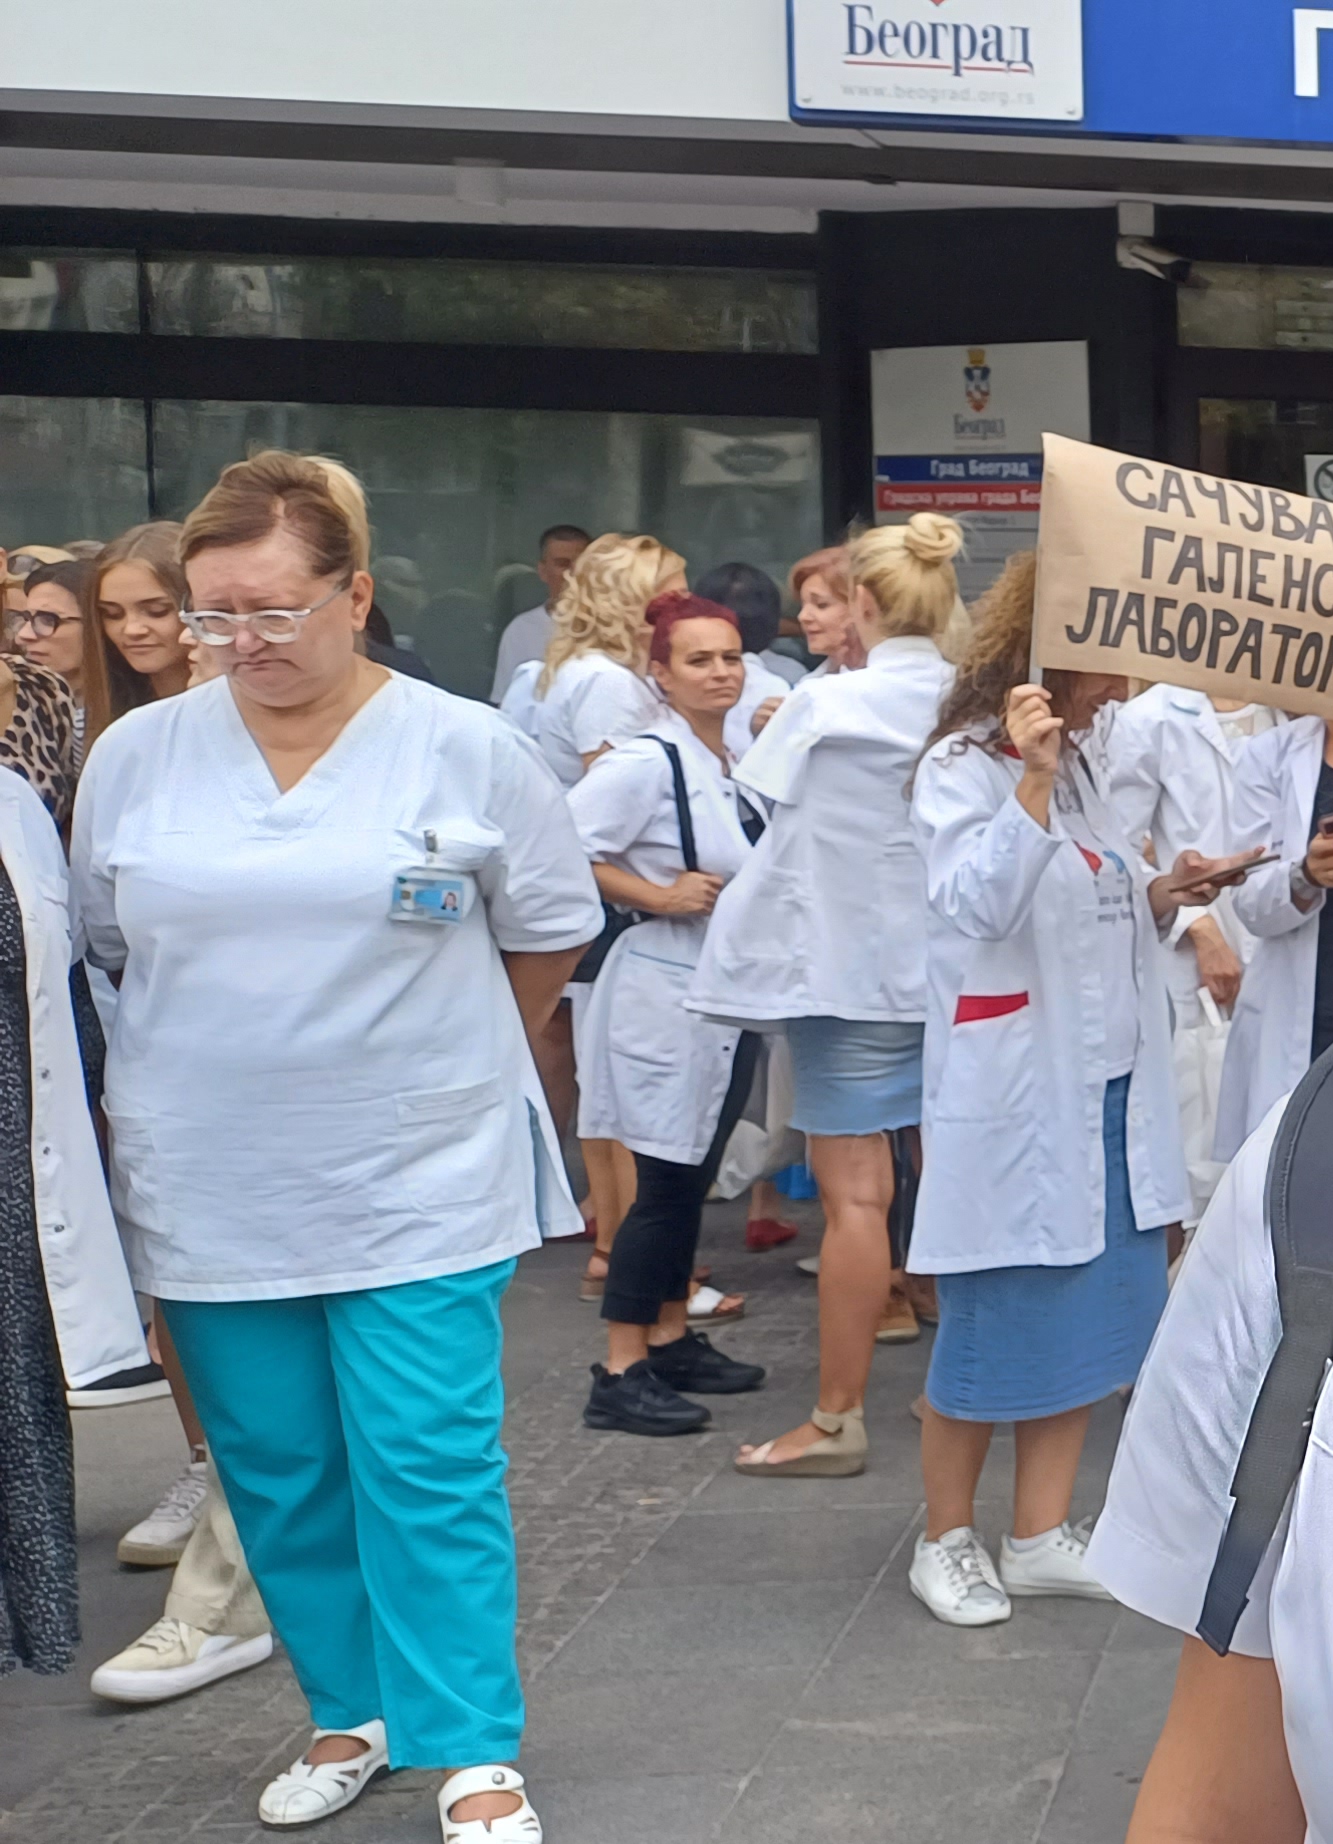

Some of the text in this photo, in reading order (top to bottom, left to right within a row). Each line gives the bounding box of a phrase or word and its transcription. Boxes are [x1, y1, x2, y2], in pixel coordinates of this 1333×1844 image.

[842, 3, 1035, 77] Београд
[840, 84, 1035, 105] www.beograd.org.rs
[930, 459, 1029, 478] Град Београд
